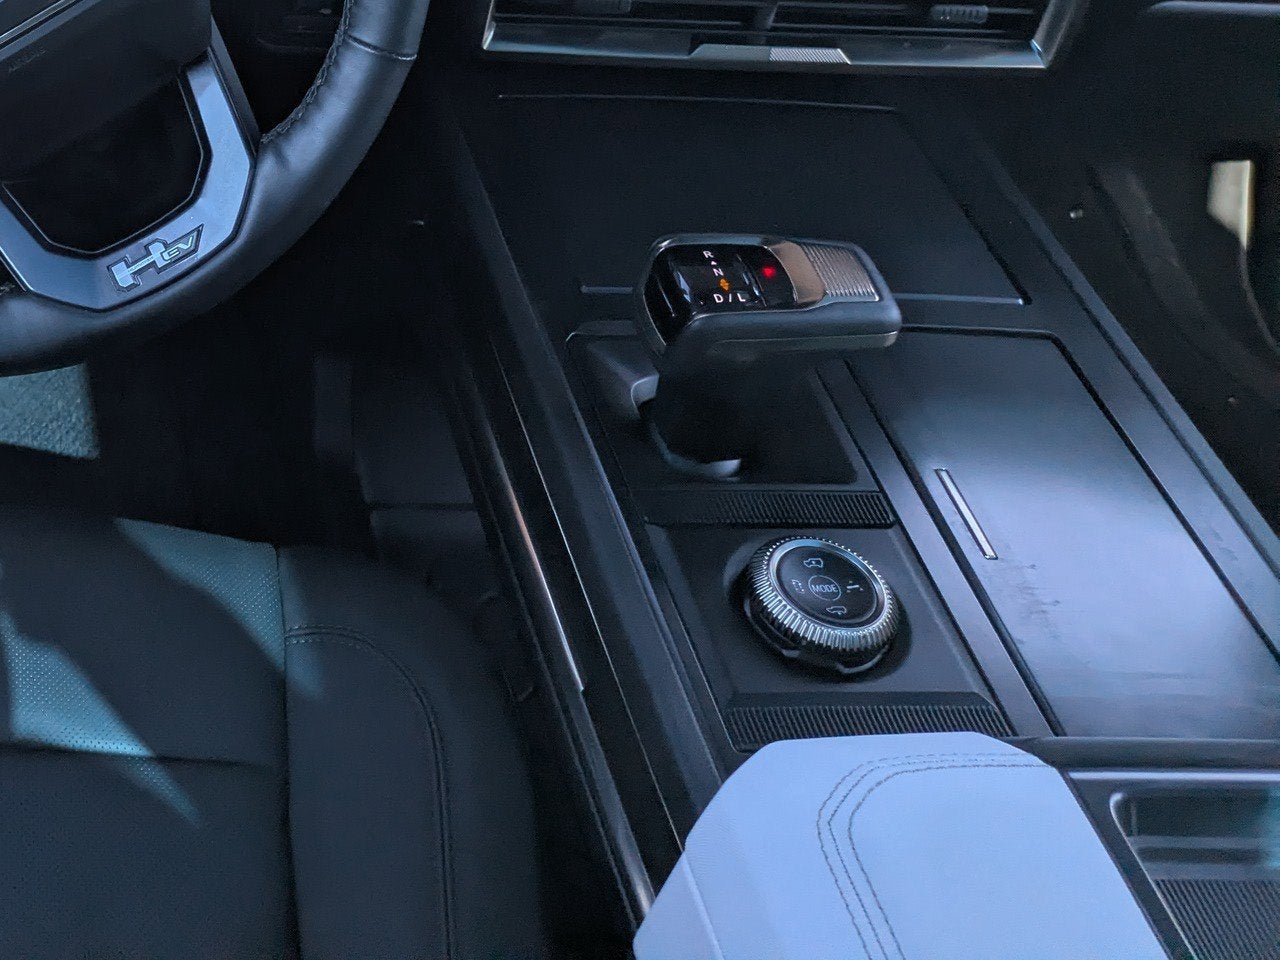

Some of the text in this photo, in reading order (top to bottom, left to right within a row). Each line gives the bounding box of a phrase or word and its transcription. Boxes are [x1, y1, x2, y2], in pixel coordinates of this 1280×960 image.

[703, 251, 714, 259] R
[714, 268, 724, 277] N
[811, 584, 837, 593] MODE
